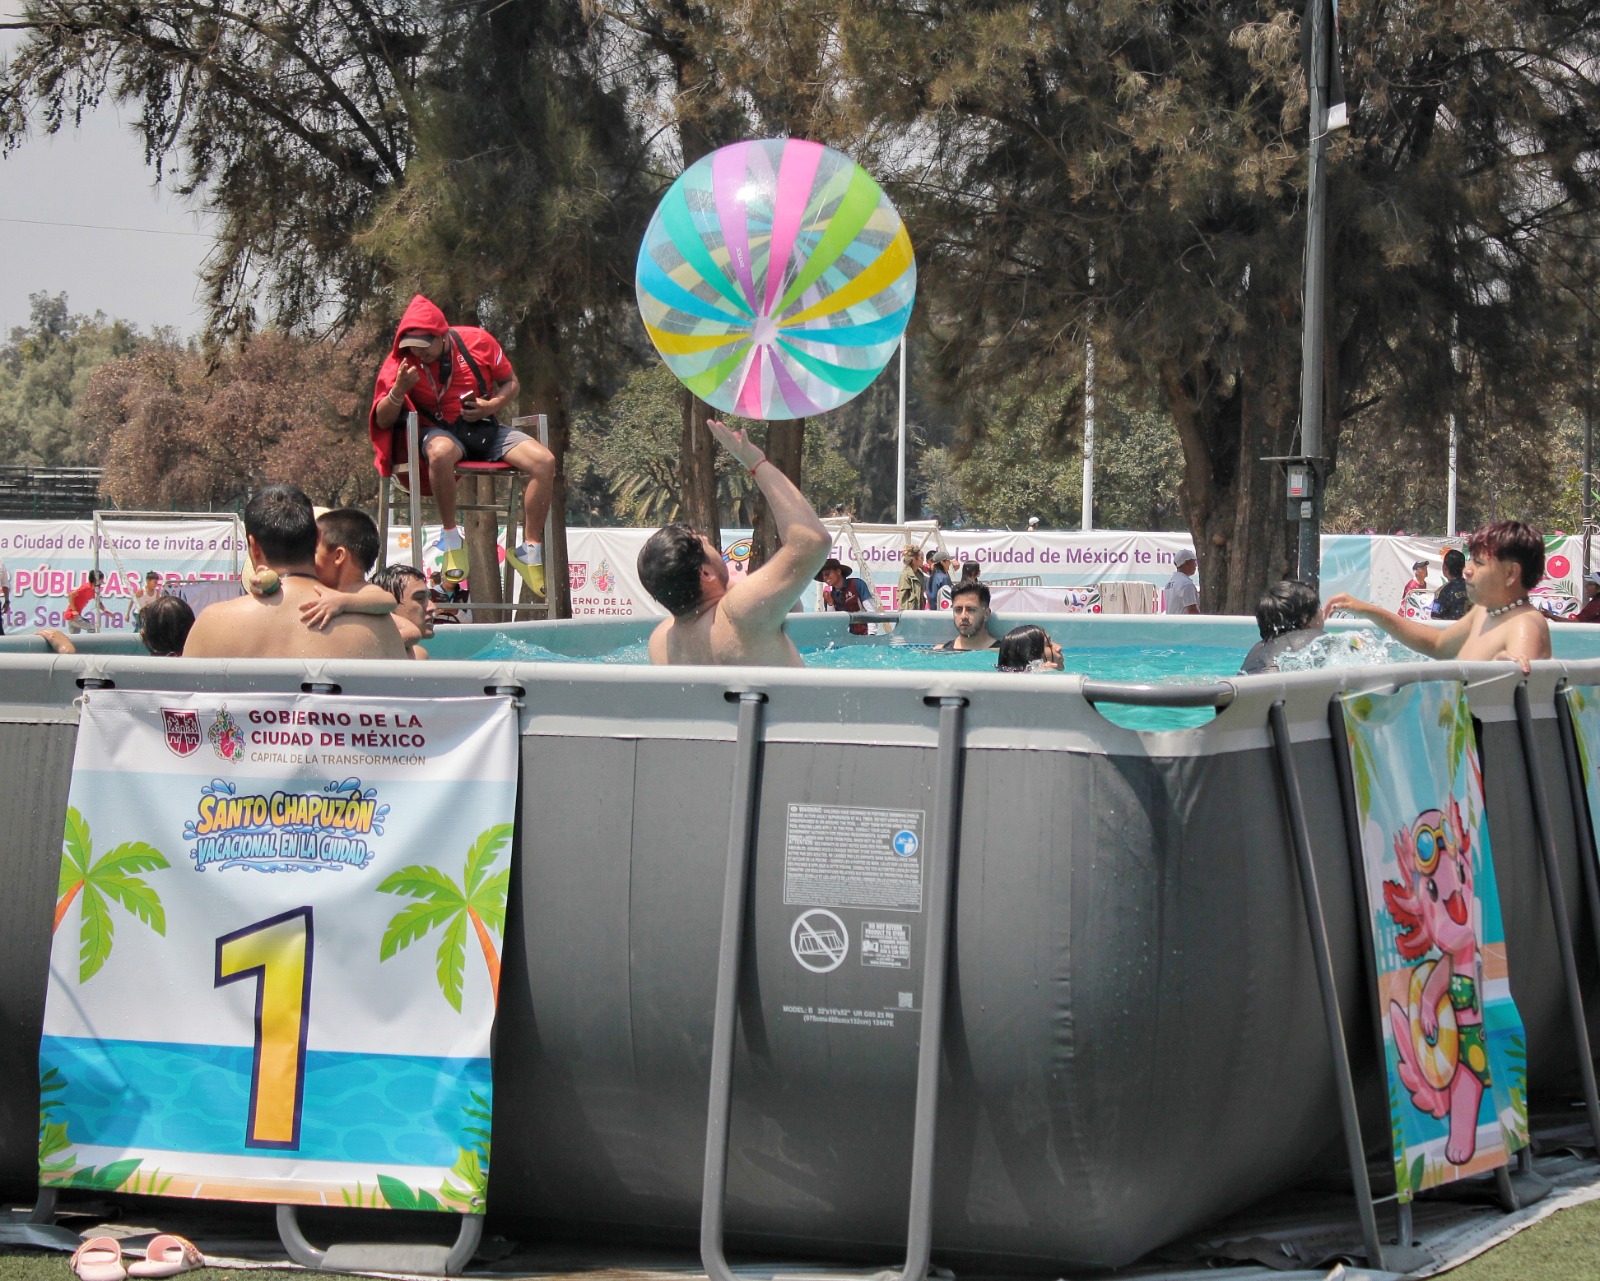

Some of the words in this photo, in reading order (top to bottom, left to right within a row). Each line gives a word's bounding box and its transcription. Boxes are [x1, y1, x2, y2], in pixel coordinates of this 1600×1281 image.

[13, 535, 63, 549] Ciudad
[67, 535, 85, 549] de
[146, 537, 160, 550] te
[164, 536, 204, 551] invita
[208, 539, 217, 551] a
[222, 536, 247, 551] dis
[829, 546, 843, 560] El
[955, 547, 970, 563] la
[974, 547, 1034, 563] Ciudad
[1039, 547, 1061, 563] de
[1066, 548, 1129, 564] México
[1133, 549, 1152, 564] te
[572, 597, 600, 605] ERNO
[603, 598, 616, 606] DE
[620, 598, 632, 606] LA
[583, 607, 596, 615] DE
[598, 606, 633, 616] MÉXICO
[248, 709, 352, 727] GOBIERNO
[359, 713, 388, 728] DE
[394, 714, 423, 728] LA
[251, 730, 314, 746] CIUDAD
[320, 732, 346, 747] DE
[351, 729, 426, 748] MÉXICO
[250, 751, 288, 764] CAPITAL
[290, 754, 303, 764] DE
[305, 754, 319, 764] LA
[321, 752, 426, 766] TRANSFORMACIÓN
[196, 793, 268, 836] SANTO
[270, 789, 377, 834] CHAPUZÓN
[197, 833, 277, 866] VACACIONAL
[279, 833, 299, 858] EN
[299, 833, 318, 860] LA
[319, 835, 368, 866] CIUDAD
[214, 905, 314, 1151] 1
